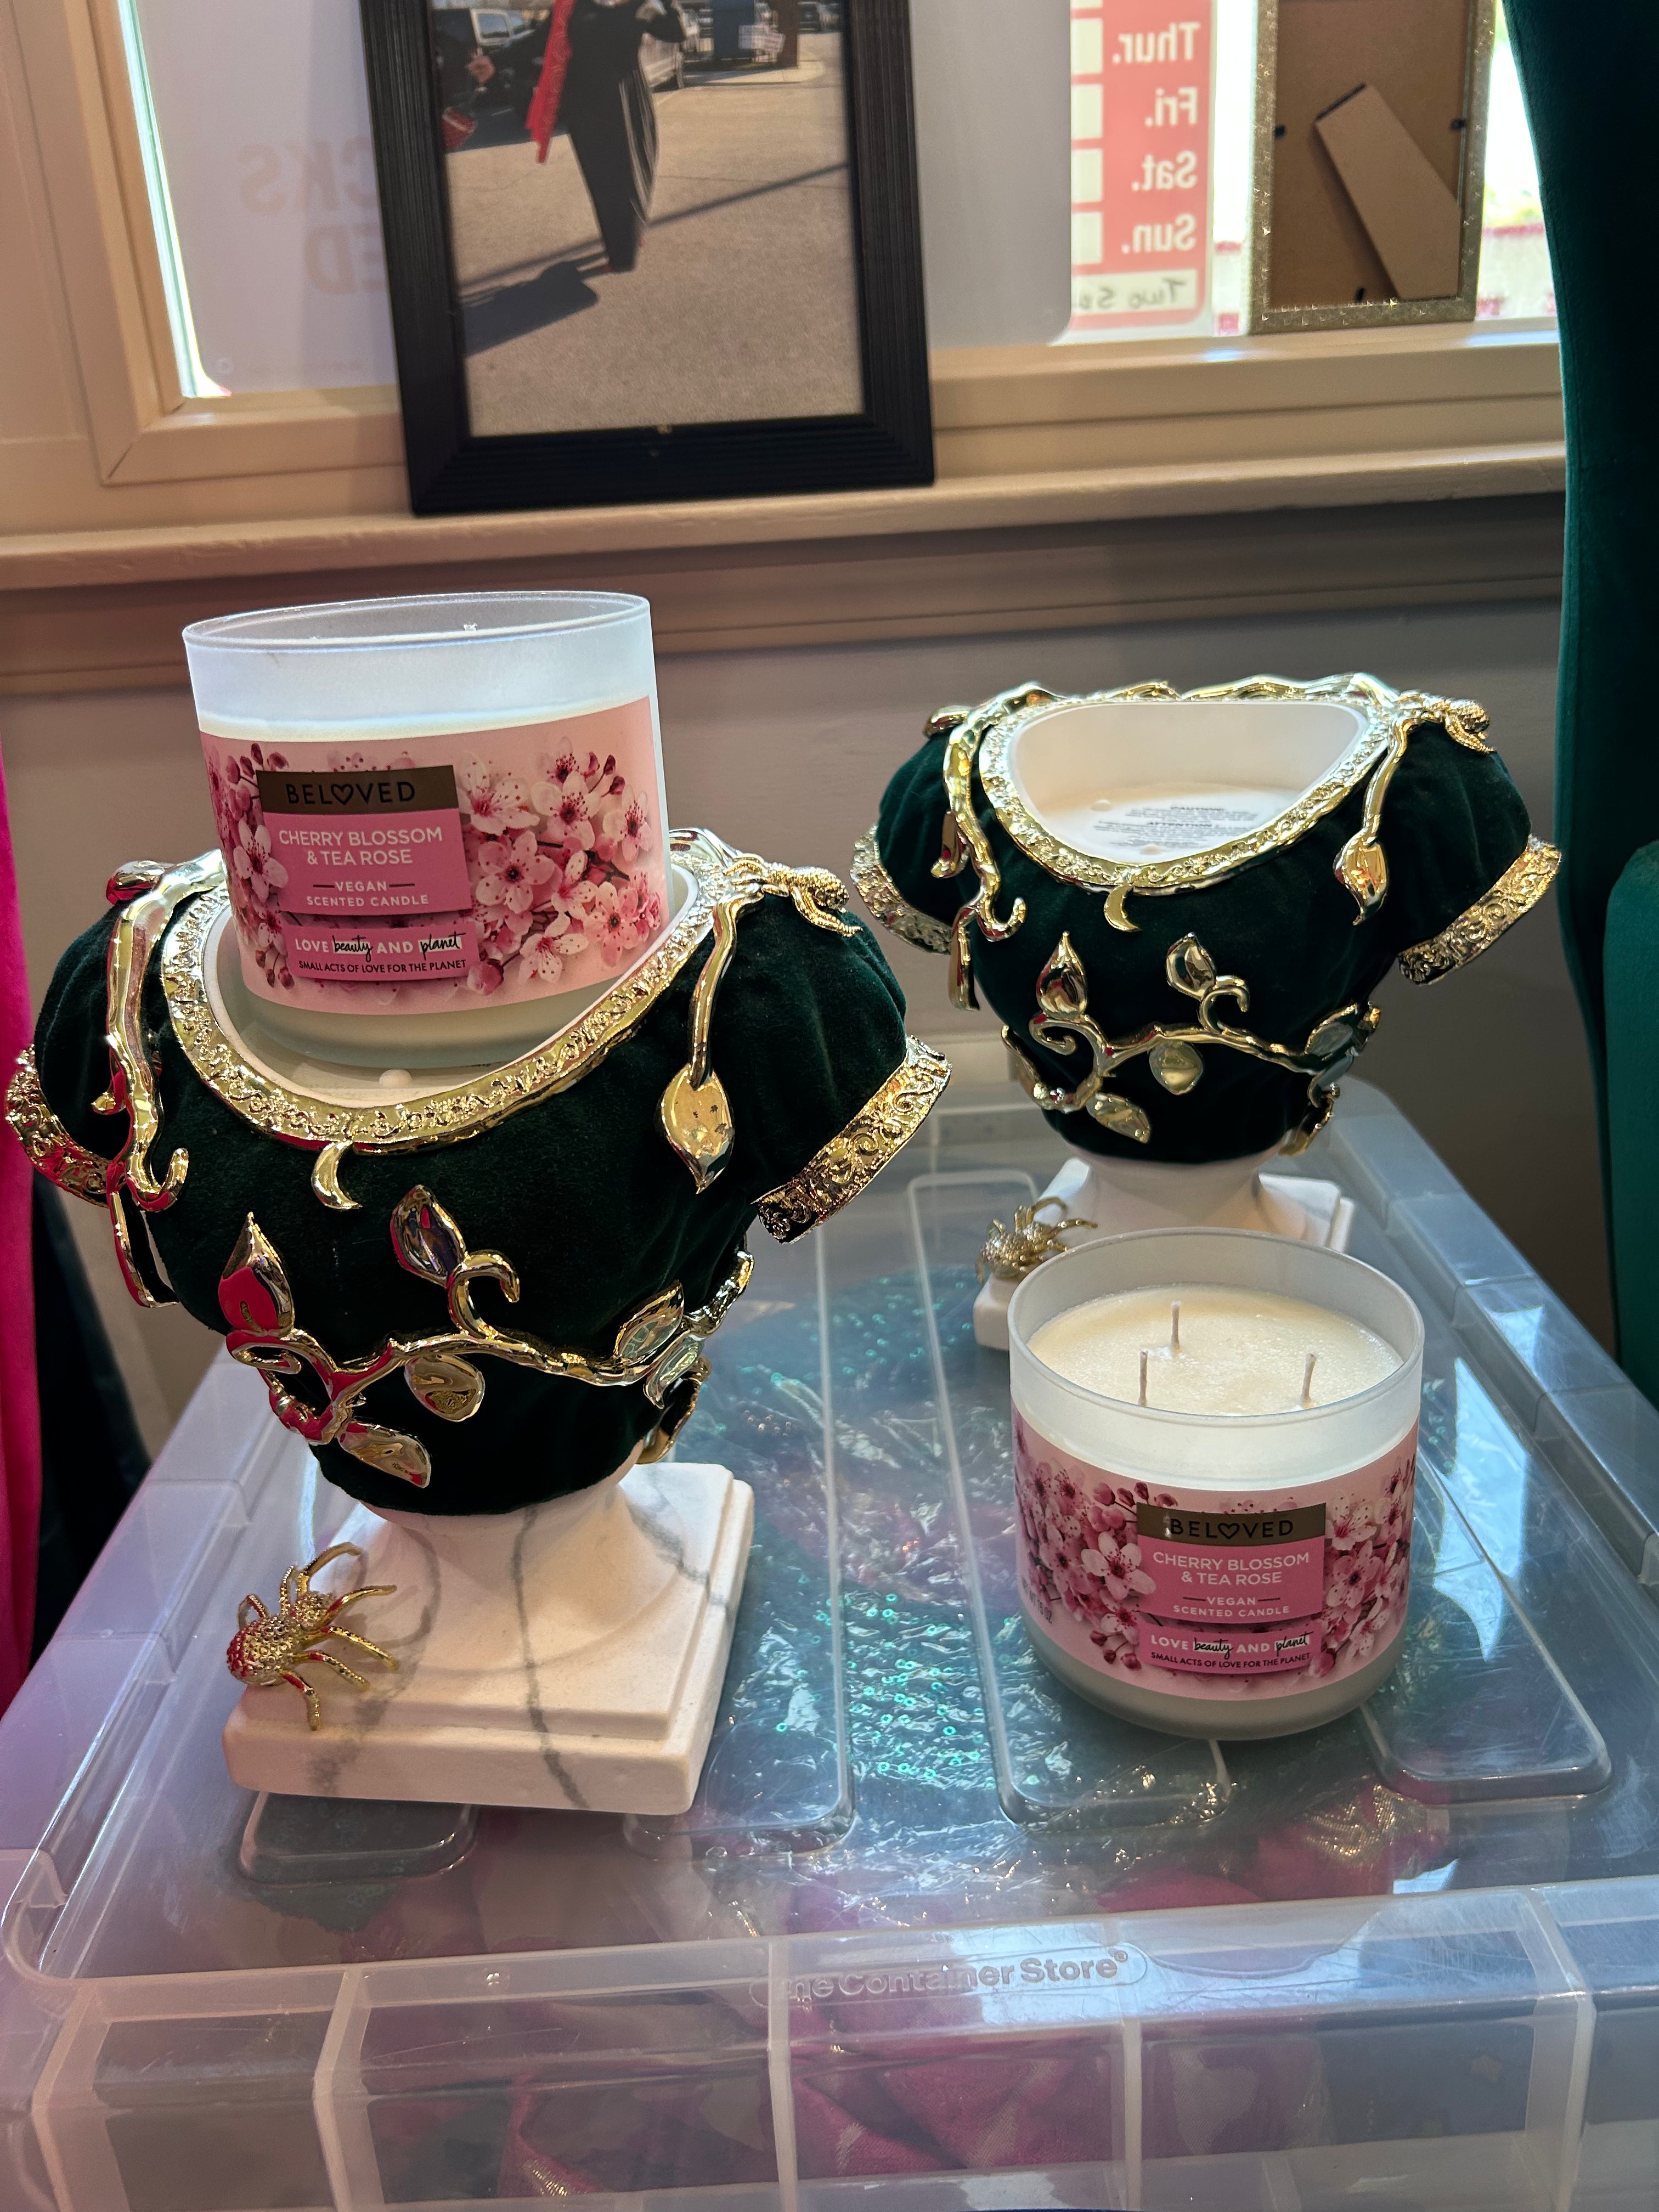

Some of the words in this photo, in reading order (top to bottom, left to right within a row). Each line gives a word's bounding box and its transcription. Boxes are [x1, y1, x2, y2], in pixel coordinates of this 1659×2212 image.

[279, 830, 344, 846] CHERRY
[348, 827, 443, 846] BLOSSOM
[307, 850, 318, 865] &
[320, 850, 357, 866] TEA
[360, 849, 413, 865] ROSE
[335, 881, 387, 892] VEGAN
[306, 895, 365, 907] SCENTED
[370, 894, 430, 906] CANDLE
[295, 939, 329, 953] LOVE
[331, 935, 374, 962] beauty
[376, 941, 414, 954] AND
[420, 931, 466, 961] planet
[299, 961, 323, 971] SMALL
[324, 963, 345, 972] ACTS
[347, 964, 359, 973] OF
[362, 964, 385, 973] LOVE
[387, 964, 407, 973] FOR
[409, 962, 427, 972] THE
[429, 960, 466, 970] PLANET
[1153, 1551, 1223, 1570] CHERRY
[1228, 1552, 1310, 1571] BLOSSOM
[1181, 1571, 1193, 1583] &
[1196, 1572, 1231, 1585] TEA
[1235, 1572, 1282, 1585] ROSE
[1207, 1597, 1256, 1606] VEGAN
[1173, 1605, 1233, 1617] SCENTED
[1238, 1605, 1290, 1617] CANDLE
[1151, 1635, 1189, 1650] LOVE
[1194, 1637, 1234, 1659] beauty
[1236, 1643, 1270, 1654] AND
[1276, 1632, 1314, 1657] planet
[1151, 1651, 1178, 1663] SMALL
[1180, 1657, 1202, 1666] ACTS
[1262, 1658, 1279, 1667] THE
[1280, 1652, 1310, 1664] PLANET
